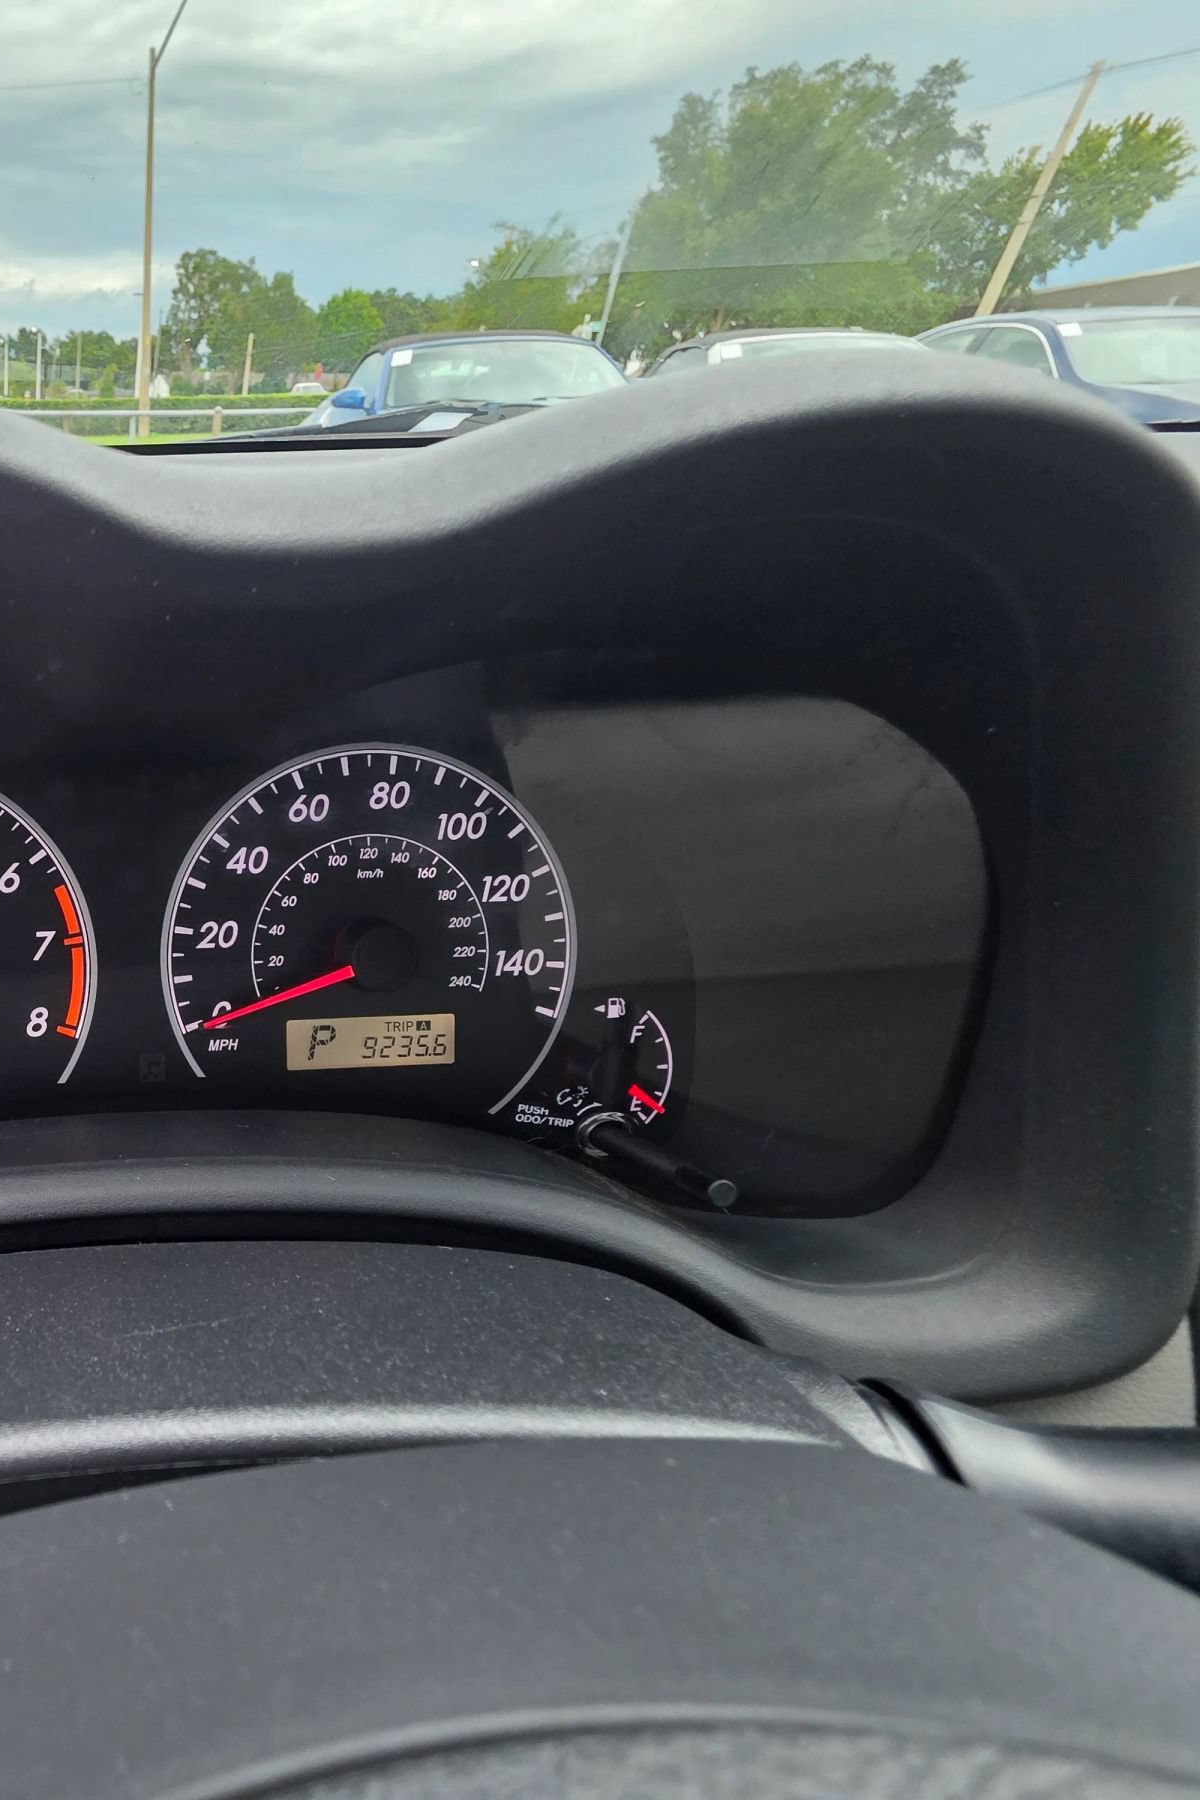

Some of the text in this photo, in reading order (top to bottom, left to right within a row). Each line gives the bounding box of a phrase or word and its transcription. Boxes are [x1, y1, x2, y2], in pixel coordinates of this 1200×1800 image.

[369, 780, 411, 810] 80
[288, 793, 330, 823] 60
[437, 809, 488, 841] 100
[225, 845, 269, 875] 40
[359, 847, 379, 860] 120
[390, 851, 410, 864] 140
[327, 854, 348, 867] 100
[302, 872, 319, 885] 80
[356, 868, 384, 879] km/h
[417, 866, 437, 879] 160
[481, 873, 531, 903] 120
[280, 895, 298, 908] 60
[437, 889, 457, 901] 180
[447, 916, 472, 929] 200
[195, 920, 239, 949] 20
[268, 924, 286, 936] 40
[32, 930, 57, 961] 7
[452, 945, 476, 958] 220
[267, 955, 285, 967] 20
[495, 948, 545, 977] 140
[448, 975, 472, 987] 240
[26, 1006, 49, 1038] 8
[384, 1021, 415, 1032] TRIP
[629, 1025, 646, 1044] F
[208, 1038, 239, 1052] MPH
[307, 1025, 337, 1060] P
[517, 1103, 549, 1116] PUSH
[630, 1096, 642, 1112] E
[515, 1113, 574, 1128] ODO/TRIP
